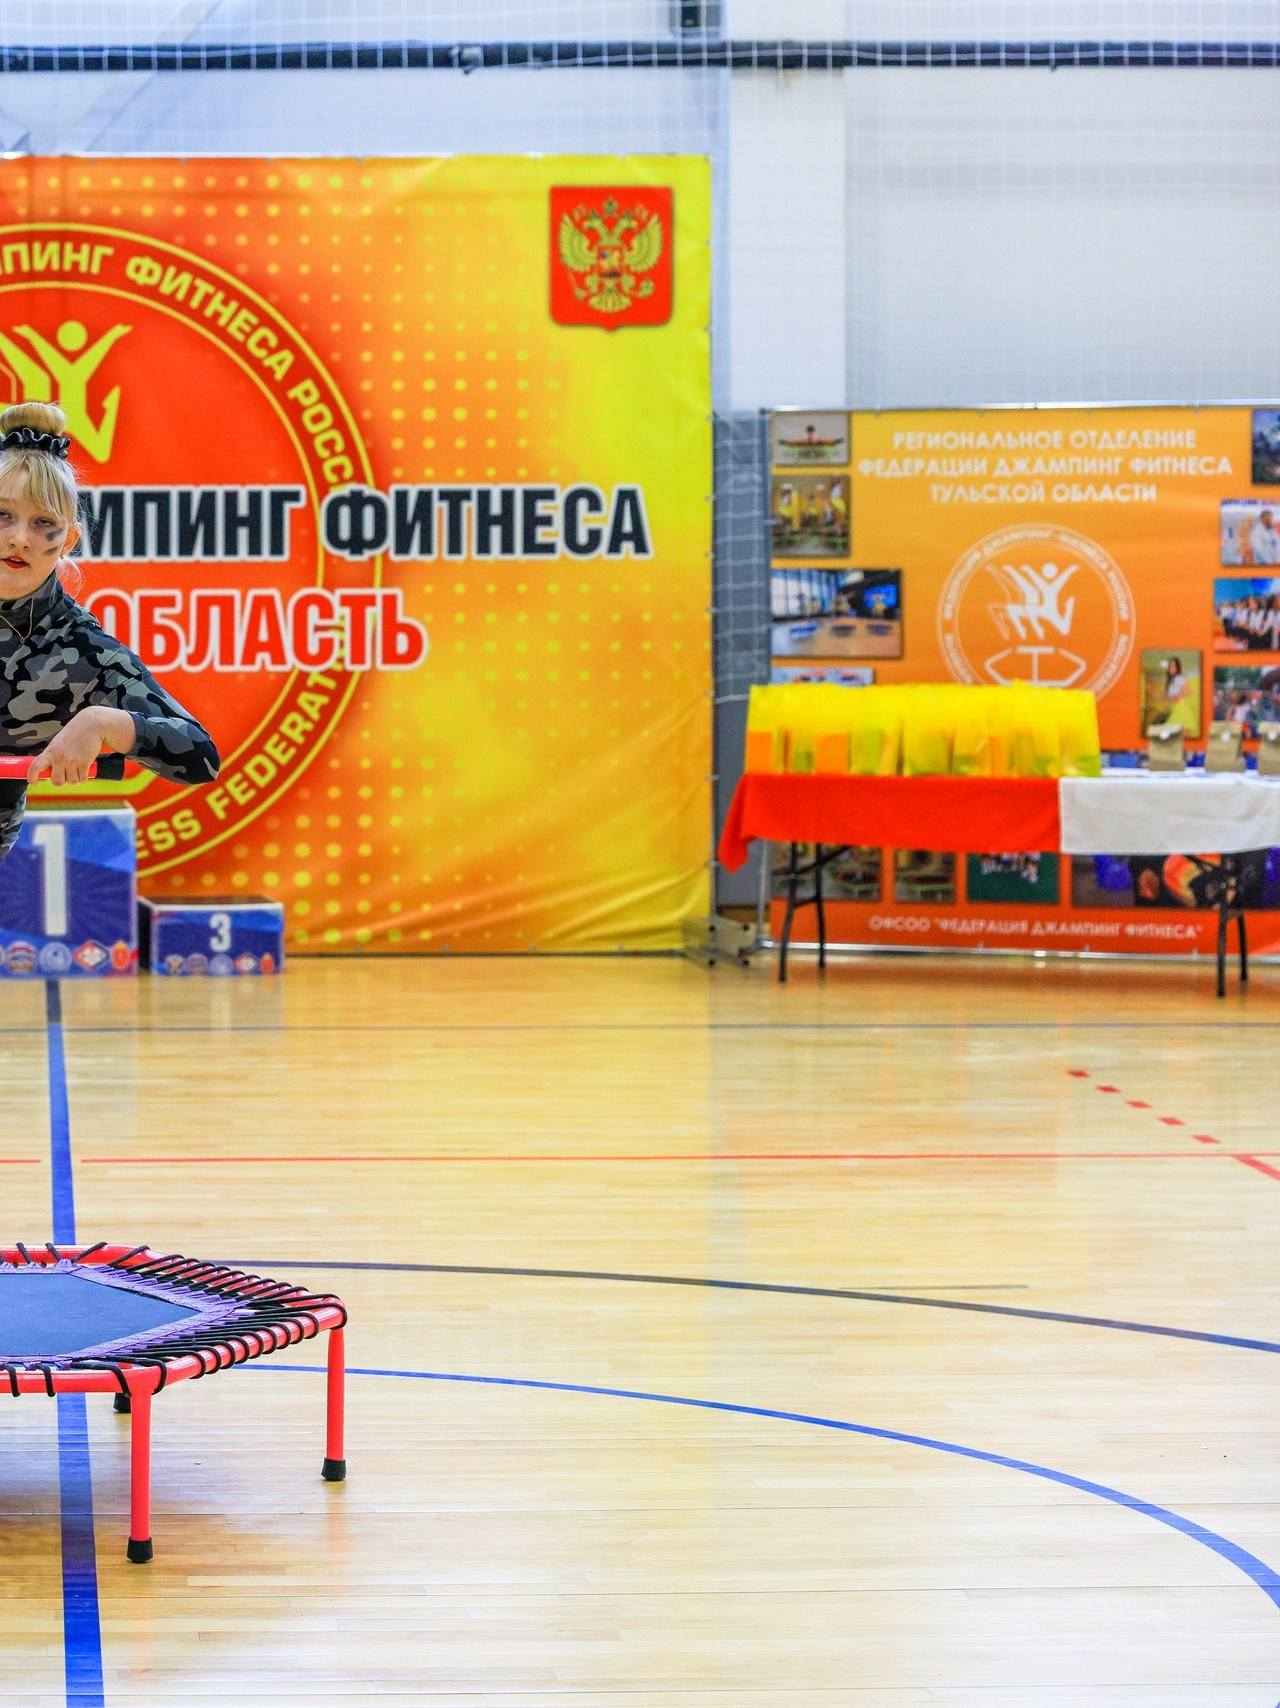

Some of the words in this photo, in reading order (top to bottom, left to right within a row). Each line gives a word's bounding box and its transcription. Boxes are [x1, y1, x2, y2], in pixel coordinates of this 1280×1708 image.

[125, 254, 296, 381] ФИТНЕСА
[287, 378, 358, 492] РОСС
[858, 457, 988, 478] ФЕДЕРАЦИИ
[992, 456, 1124, 477] ДЖАМПИНГ
[1129, 456, 1233, 476] ФИТНЕСА
[893, 430, 1064, 450] РЕГИОНАЛЬНОЕ
[1069, 429, 1197, 450] ОТДЕЛЕНИЕ
[930, 480, 1046, 503] ТУЛЬСКОЙ
[1051, 482, 1158, 503] ОБЛАСТИ
[322, 484, 652, 559] ФИТНЕСА
[86, 588, 428, 672] ОБЛАСТЬ
[33, 824, 67, 936] 1
[209, 913, 232, 953] 3
